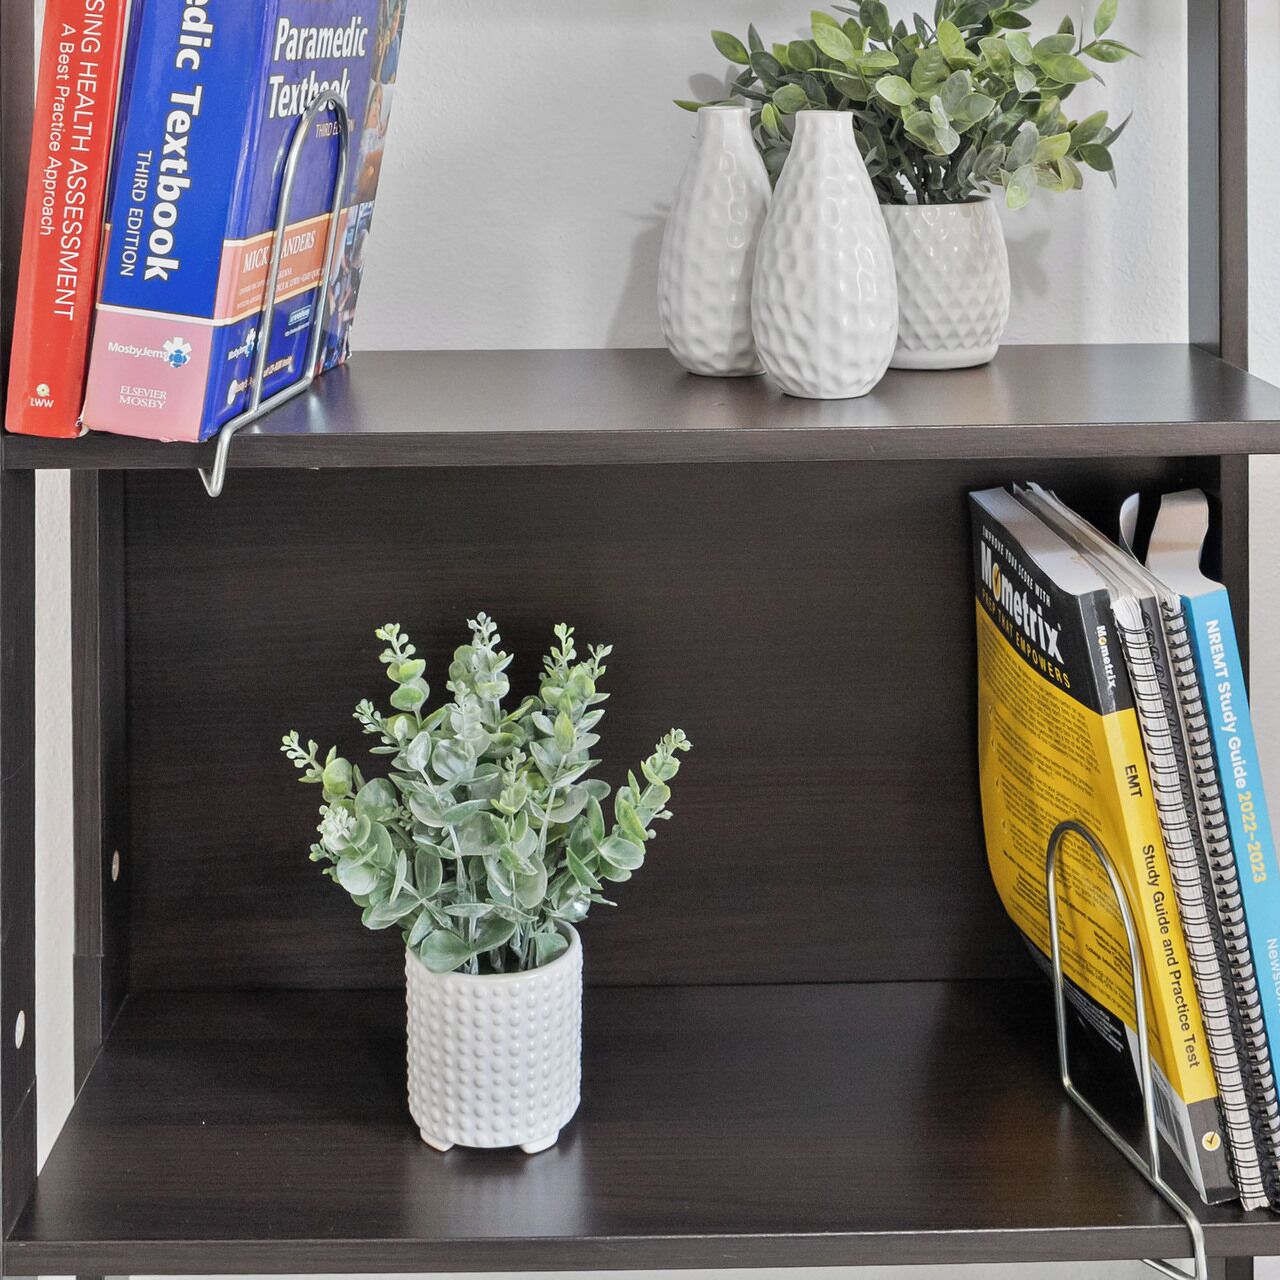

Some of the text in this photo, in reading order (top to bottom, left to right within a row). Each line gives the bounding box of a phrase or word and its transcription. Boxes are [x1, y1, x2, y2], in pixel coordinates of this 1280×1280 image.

[273, 16, 368, 62] Paramedic
[39, 23, 77, 236] A Best Practice Approach
[70, 61, 99, 152] HEALTH
[120, 150, 153, 277] THIRD EDITION
[143, 84, 203, 282] Textbook
[54, 158, 89, 321] ASSESSMENT
[242, 246, 270, 273] MICK
[279, 230, 317, 259] ANDERS
[30, 397, 54, 408] LWW
[119, 395, 167, 409] MOSBY
[120, 385, 167, 399] ELSEVIER
[980, 539, 1065, 665] Mometrix
[1034, 581, 1051, 608] WITH
[1015, 631, 1071, 690] EMPOWERS
[1096, 625, 1117, 689] Mometrix
[1124, 763, 1143, 798] EMT
[1205, 619, 1267, 884] NREMT Study Guide 2022-2023
[1142, 844, 1200, 1068] Study Guide and Practice Test
